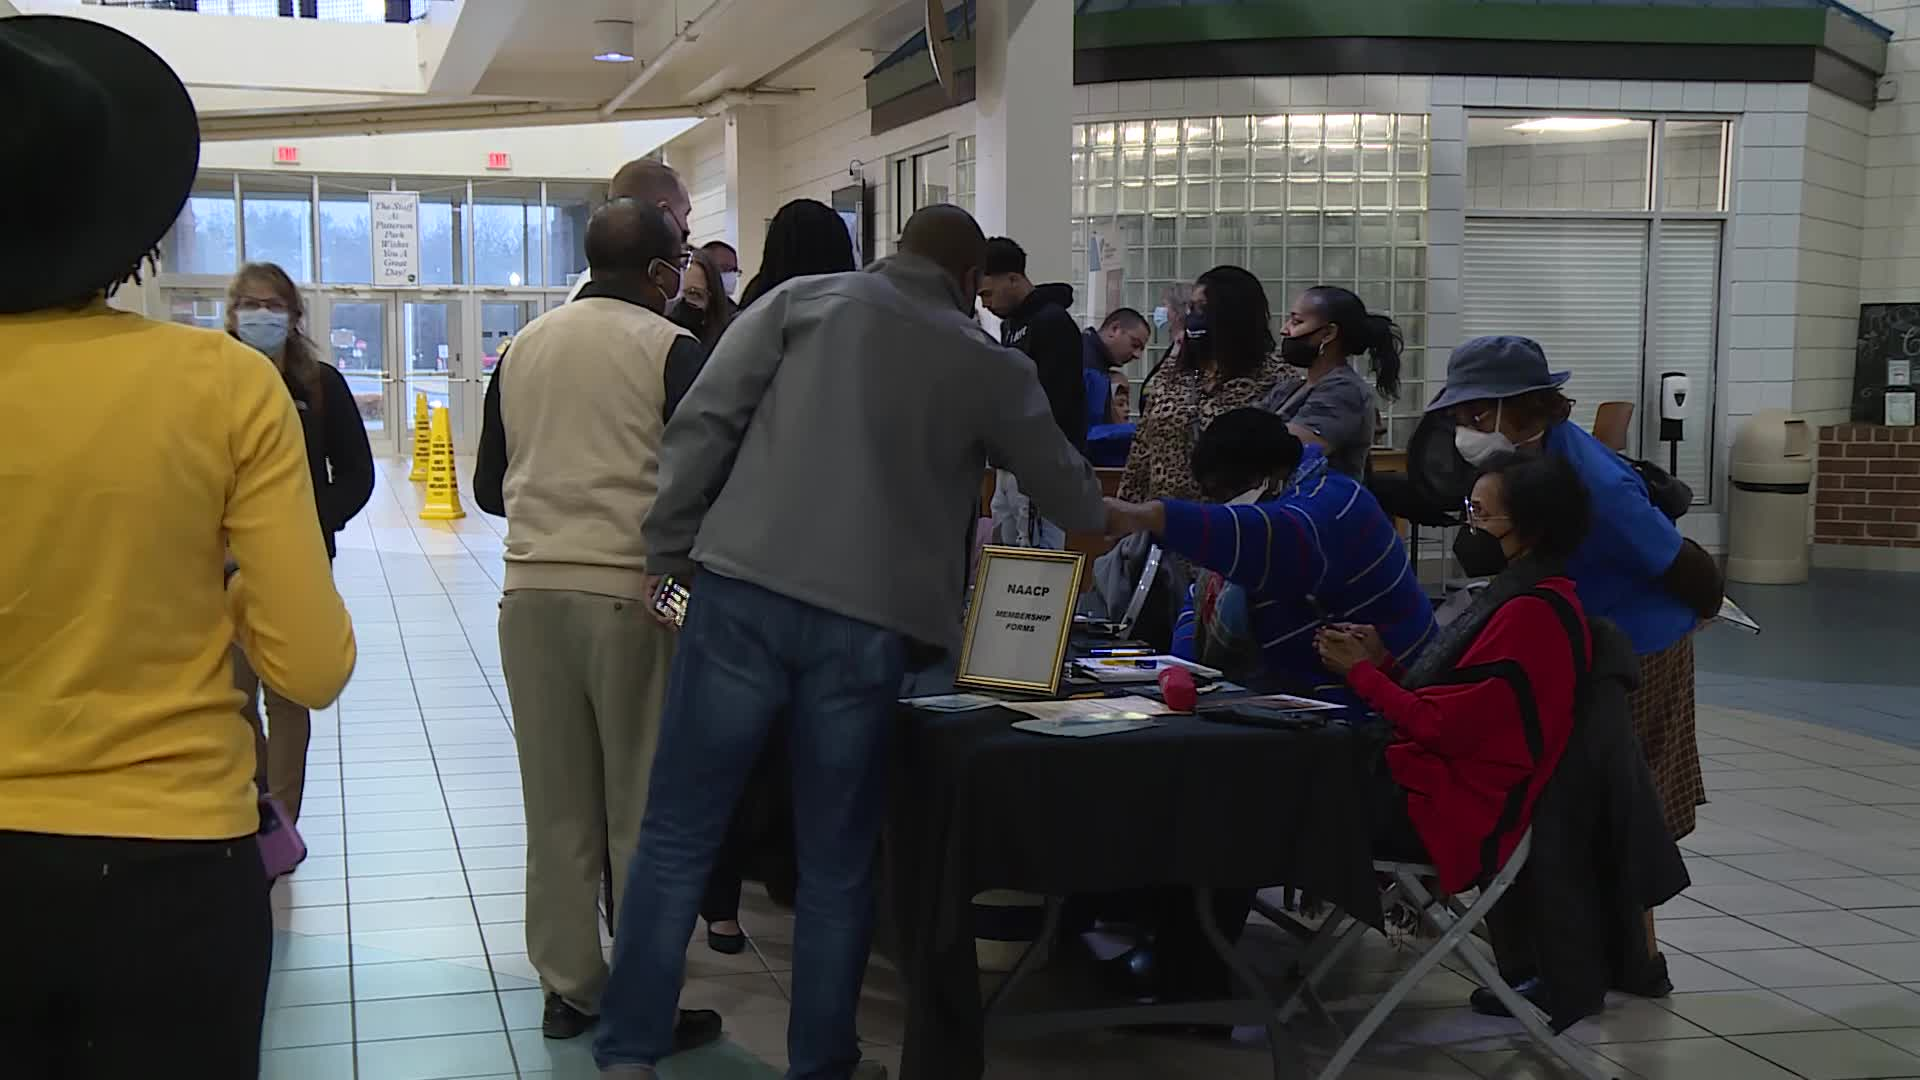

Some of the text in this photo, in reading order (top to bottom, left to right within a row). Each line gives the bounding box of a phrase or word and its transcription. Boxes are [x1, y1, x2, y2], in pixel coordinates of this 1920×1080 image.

[279, 147, 297, 160] EXIT
[489, 153, 507, 166] EXIT
[375, 202, 413, 211] The Staff
[381, 240, 408, 248] Wishes
[383, 249, 398, 257] You
[383, 259, 407, 267] Great
[1007, 584, 1050, 597] NAACP
[994, 609, 1052, 622] MEMBERSHIP
[1005, 623, 1035, 633] FORMS
